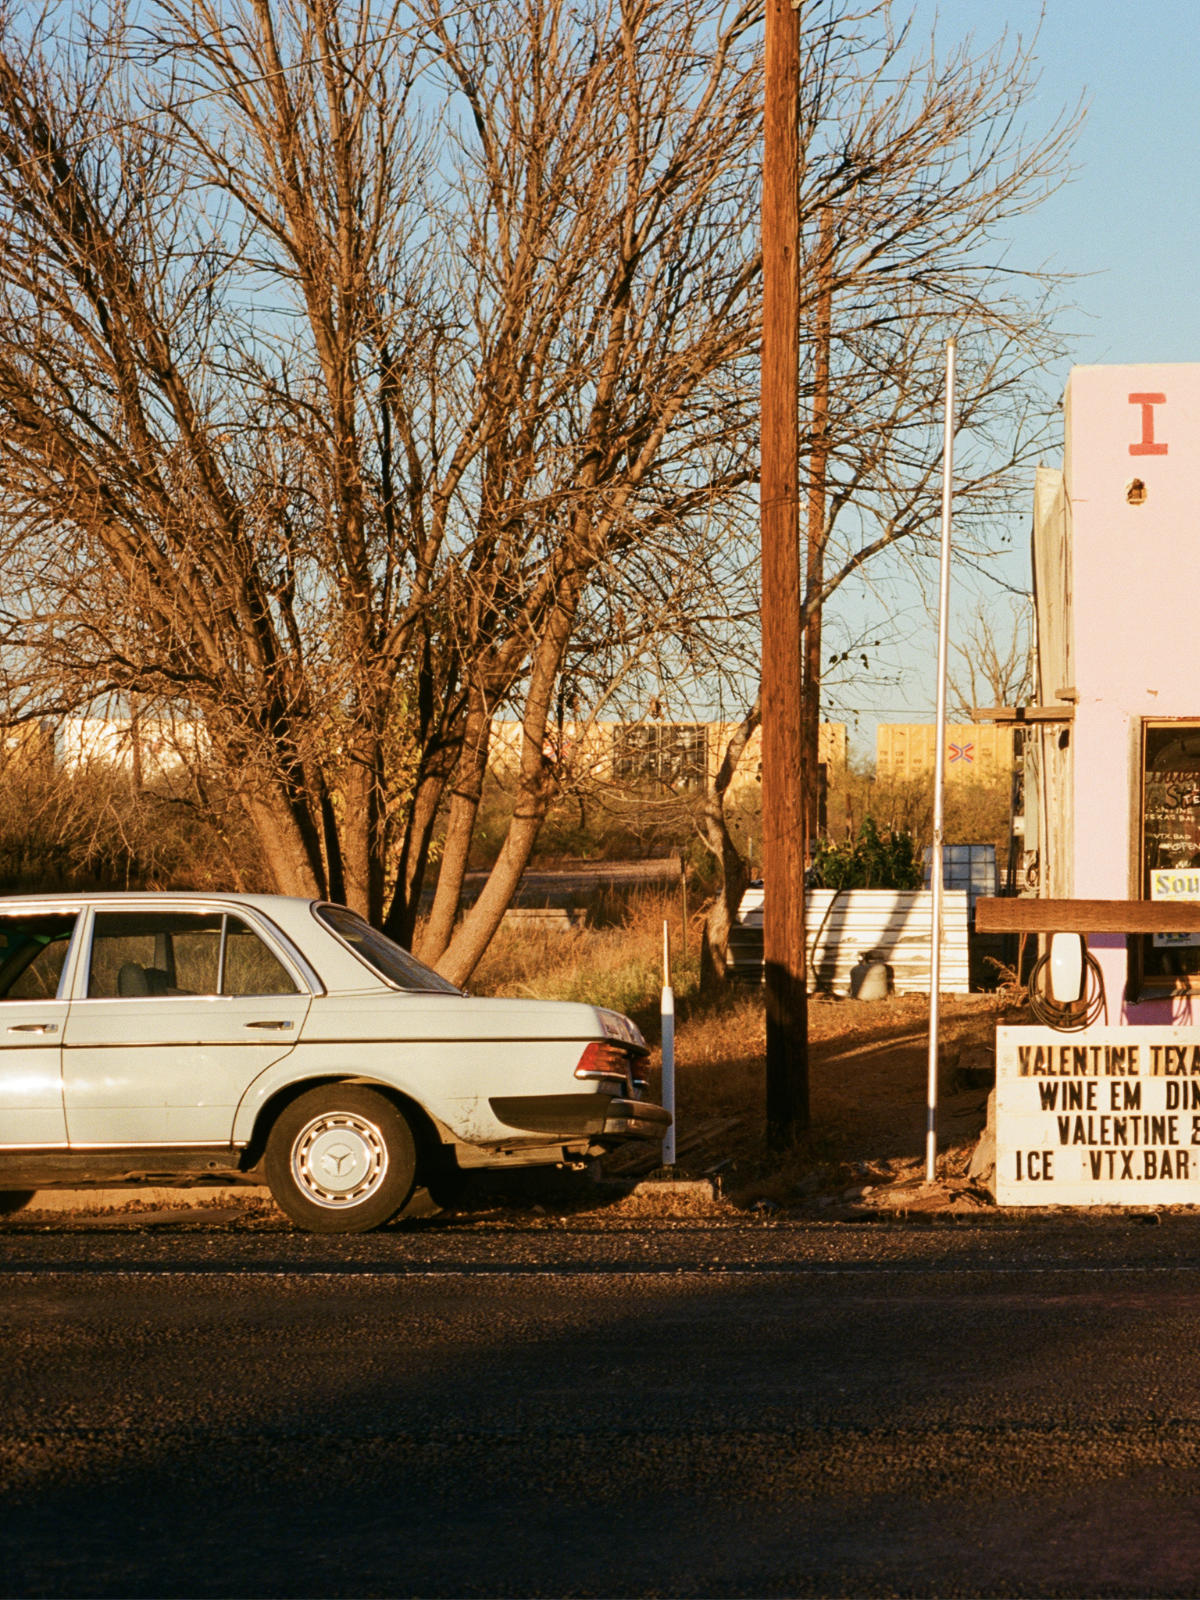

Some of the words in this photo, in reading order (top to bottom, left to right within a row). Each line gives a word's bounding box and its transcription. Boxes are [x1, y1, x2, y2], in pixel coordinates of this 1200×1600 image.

[1018, 1045, 1140, 1076] VALENTINE
[1038, 1081, 1098, 1111] WINE
[1110, 1081, 1142, 1111] EM
[1057, 1115, 1179, 1146] VALENTINE
[1016, 1150, 1054, 1181] ICE
